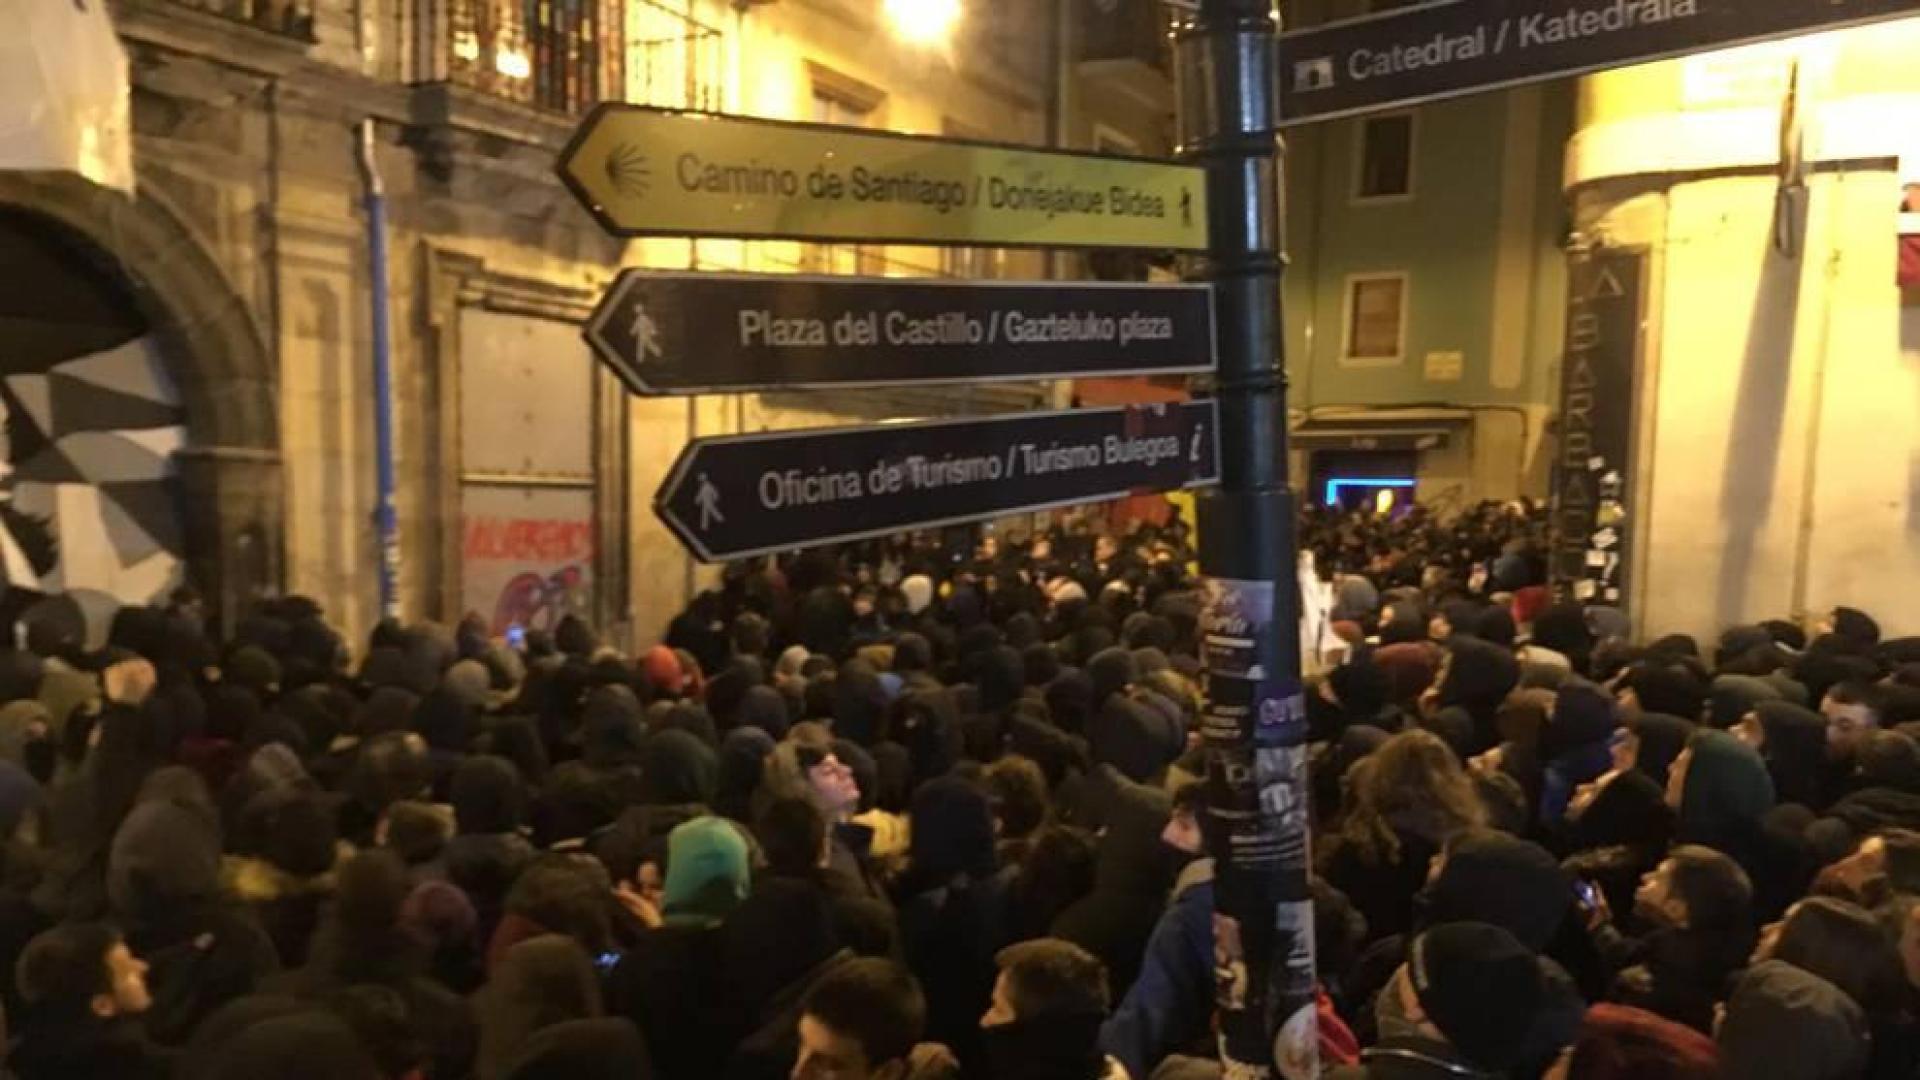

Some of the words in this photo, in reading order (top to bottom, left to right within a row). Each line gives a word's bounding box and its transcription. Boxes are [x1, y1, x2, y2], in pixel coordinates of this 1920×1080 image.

[1349, 25, 1486, 80] Catedral
[1494, 19, 1510, 54] /
[676, 152, 798, 197] Camino
[806, 164, 843, 198] de
[852, 166, 966, 214] Santiago
[968, 175, 984, 207] /
[988, 175, 1103, 220] Donejakue
[1108, 185, 1165, 218] Bidea
[738, 309, 828, 346] Plaza
[833, 310, 878, 345] del
[884, 310, 983, 345] Castillo
[987, 310, 1000, 344] /
[1003, 309, 1116, 342] Gazteluko
[1118, 310, 1174, 347] plaza
[759, 466, 862, 509] Oficina
[868, 458, 902, 496] de
[904, 452, 1002, 490] Turismo
[1004, 444, 1017, 479] /
[1020, 441, 1100, 474] Turismo
[1103, 433, 1180, 467] Bulegoa
